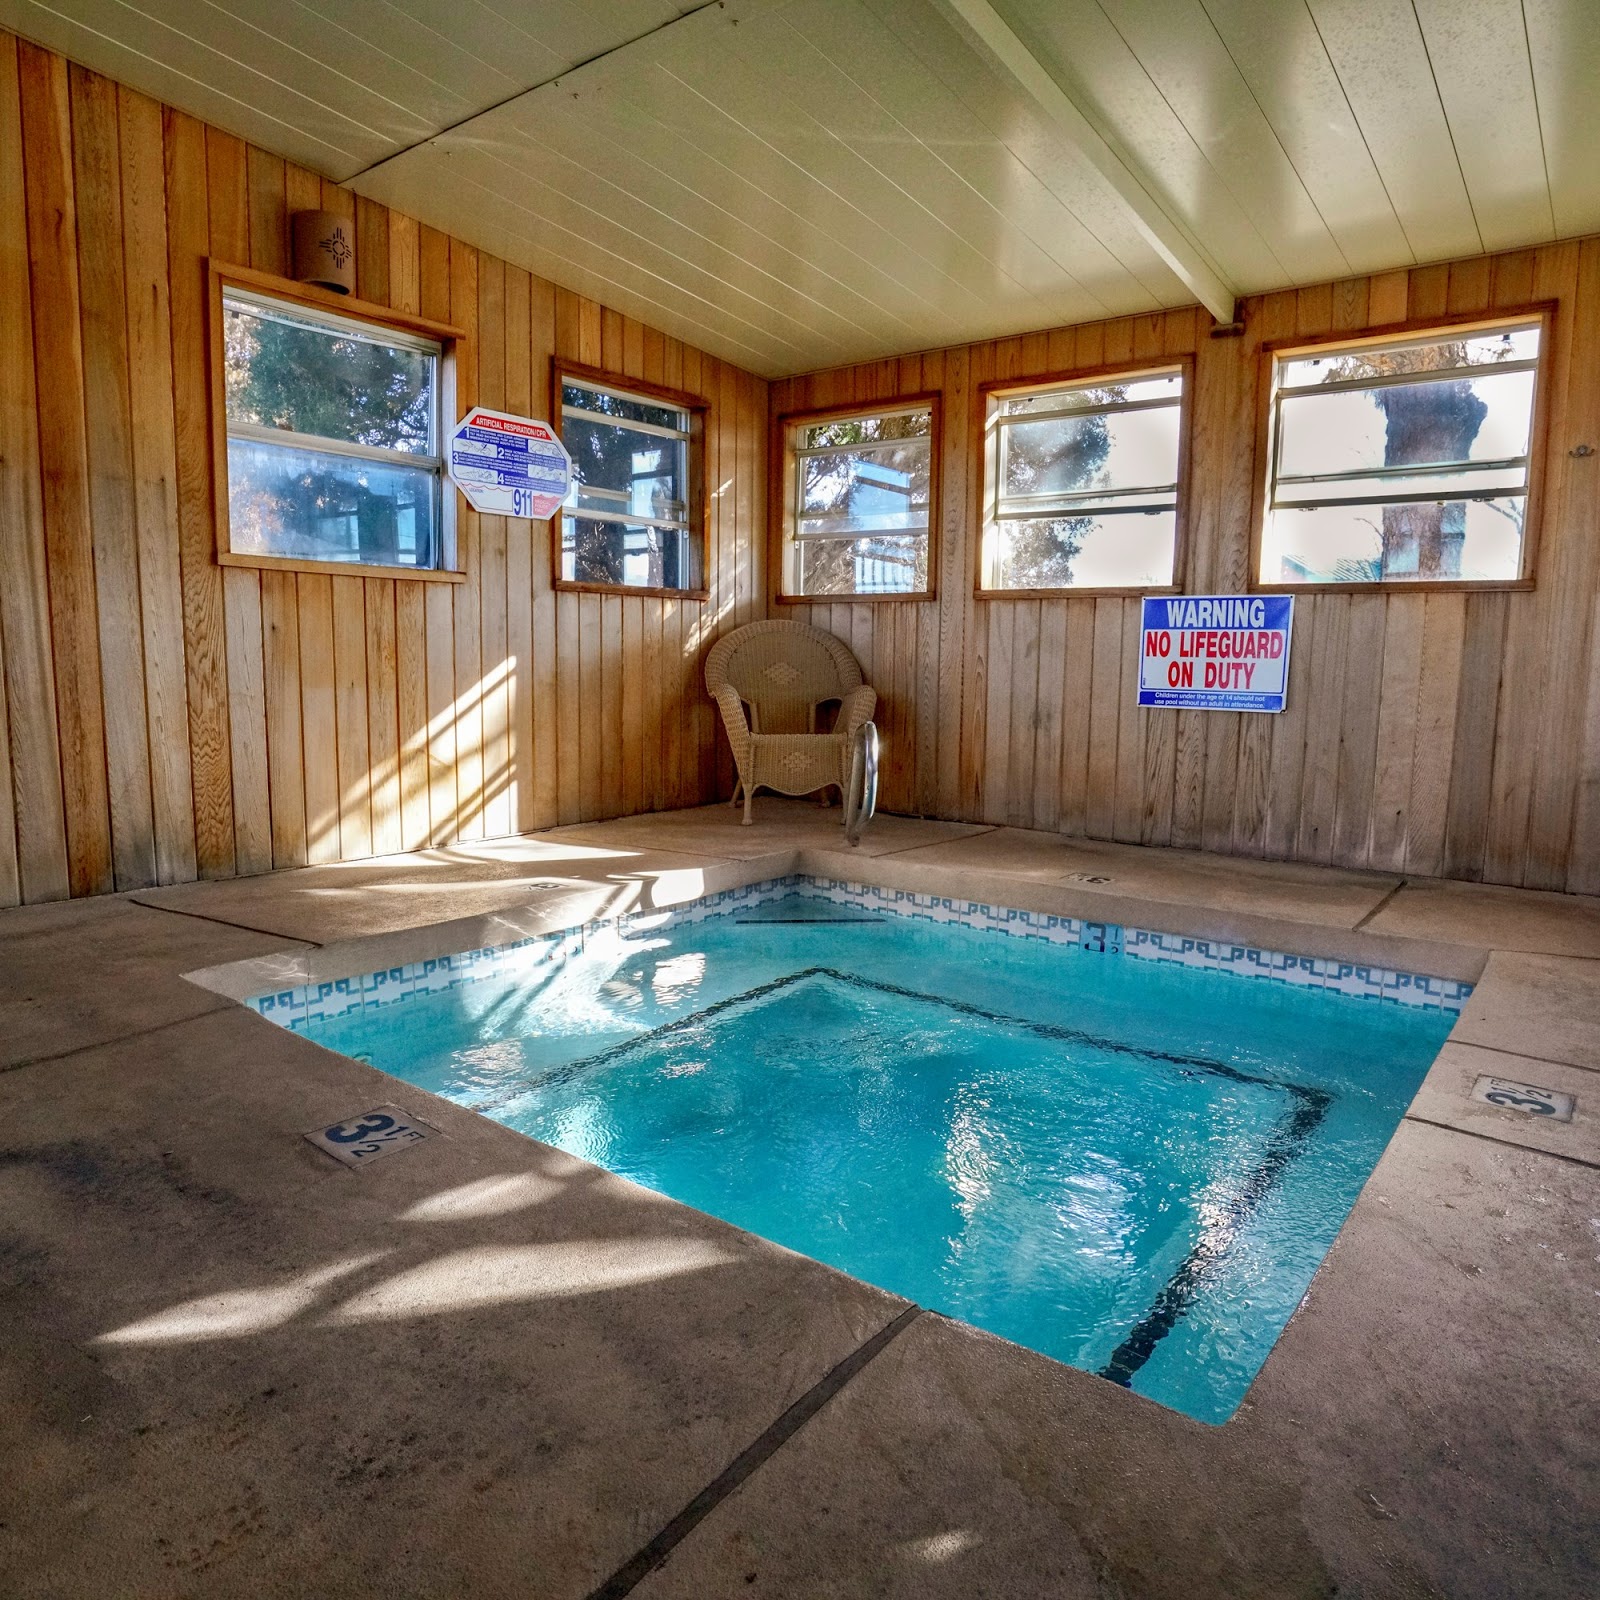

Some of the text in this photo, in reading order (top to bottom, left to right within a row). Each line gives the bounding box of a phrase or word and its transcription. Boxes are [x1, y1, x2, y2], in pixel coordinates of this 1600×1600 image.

[464, 427, 470, 439] 1
[476, 416, 503, 430] ARTIFICIAL
[453, 452, 459, 464] 3
[498, 447, 505, 459] 2
[498, 473, 505, 485] 4
[514, 488, 533, 517] 911
[1167, 599, 1265, 628] WARNING
[1146, 630, 1283, 659] NO LIFEGUARD
[1168, 661, 1256, 689] ON DUTY
[1084, 922, 1107, 953] 3
[1485, 1091, 1556, 1115] 3
[324, 1114, 396, 1144] 3
[402, 1130, 426, 1142] FT
